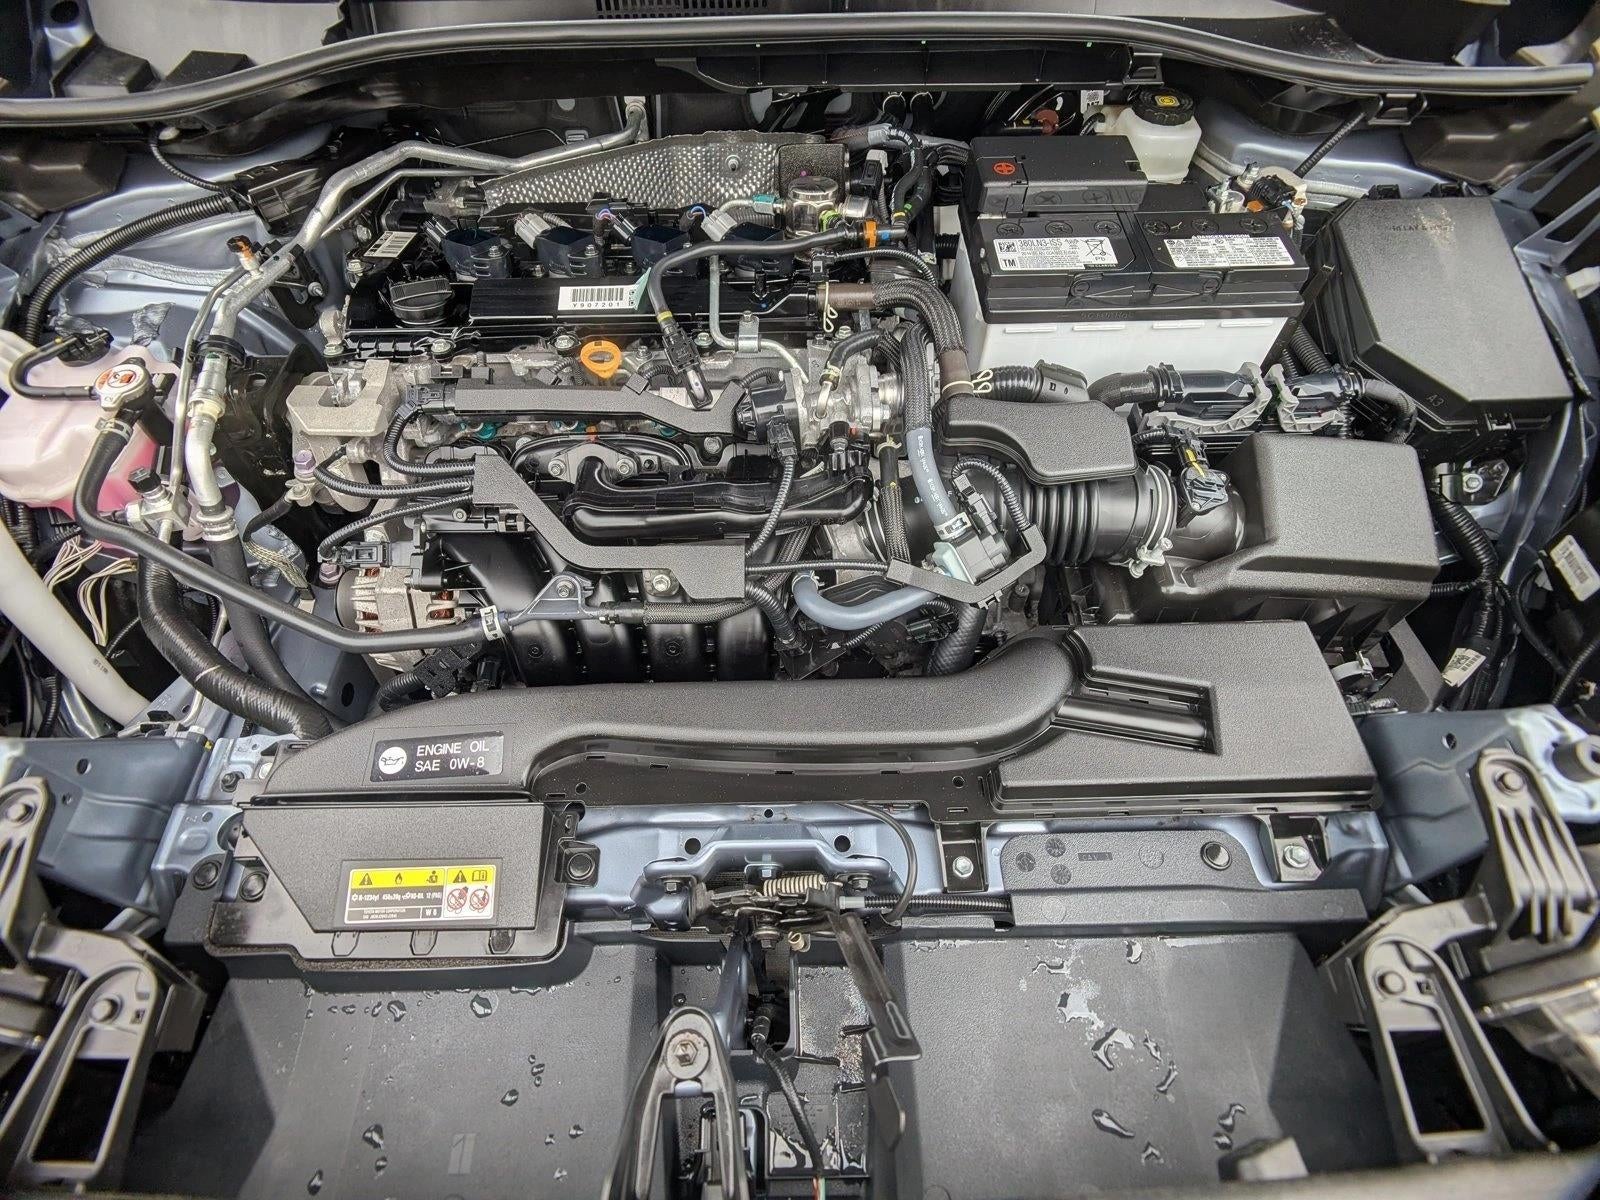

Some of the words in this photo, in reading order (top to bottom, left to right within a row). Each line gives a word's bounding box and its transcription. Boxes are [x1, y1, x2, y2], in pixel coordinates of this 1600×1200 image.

[1003, 259, 1016, 267] TM
[416, 742, 462, 757] ENGINE
[469, 740, 490, 753] OIL
[414, 759, 441, 773] SAE
[449, 756, 485, 770] 0W-8
